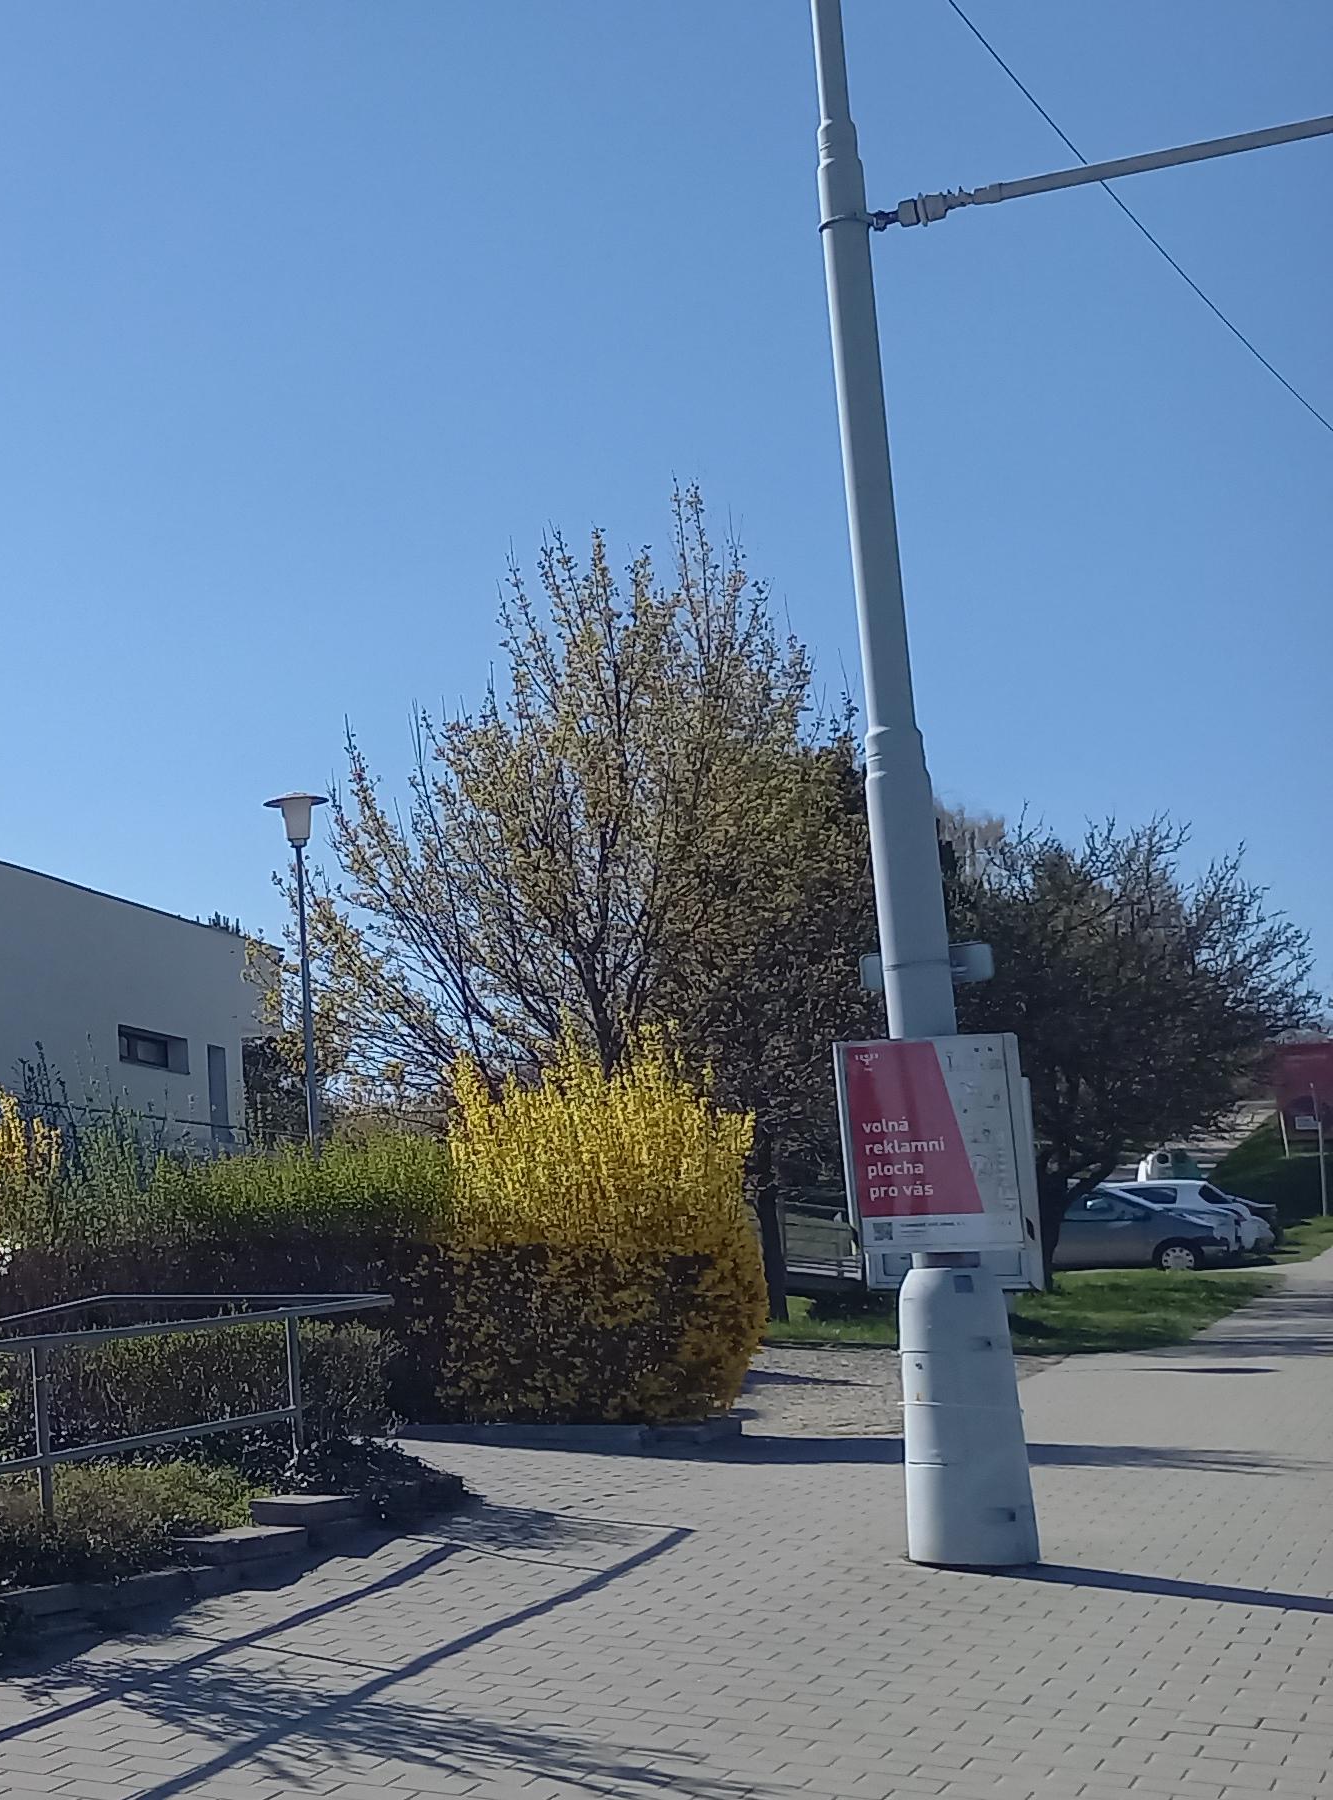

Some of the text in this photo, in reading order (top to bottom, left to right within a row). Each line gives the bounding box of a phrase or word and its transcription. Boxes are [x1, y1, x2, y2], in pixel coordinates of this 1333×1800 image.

[861, 1115, 910, 1134] volná
[864, 1135, 946, 1156] reklamní
[866, 1160, 925, 1181] plocha
[868, 1180, 935, 1202] pro vás
